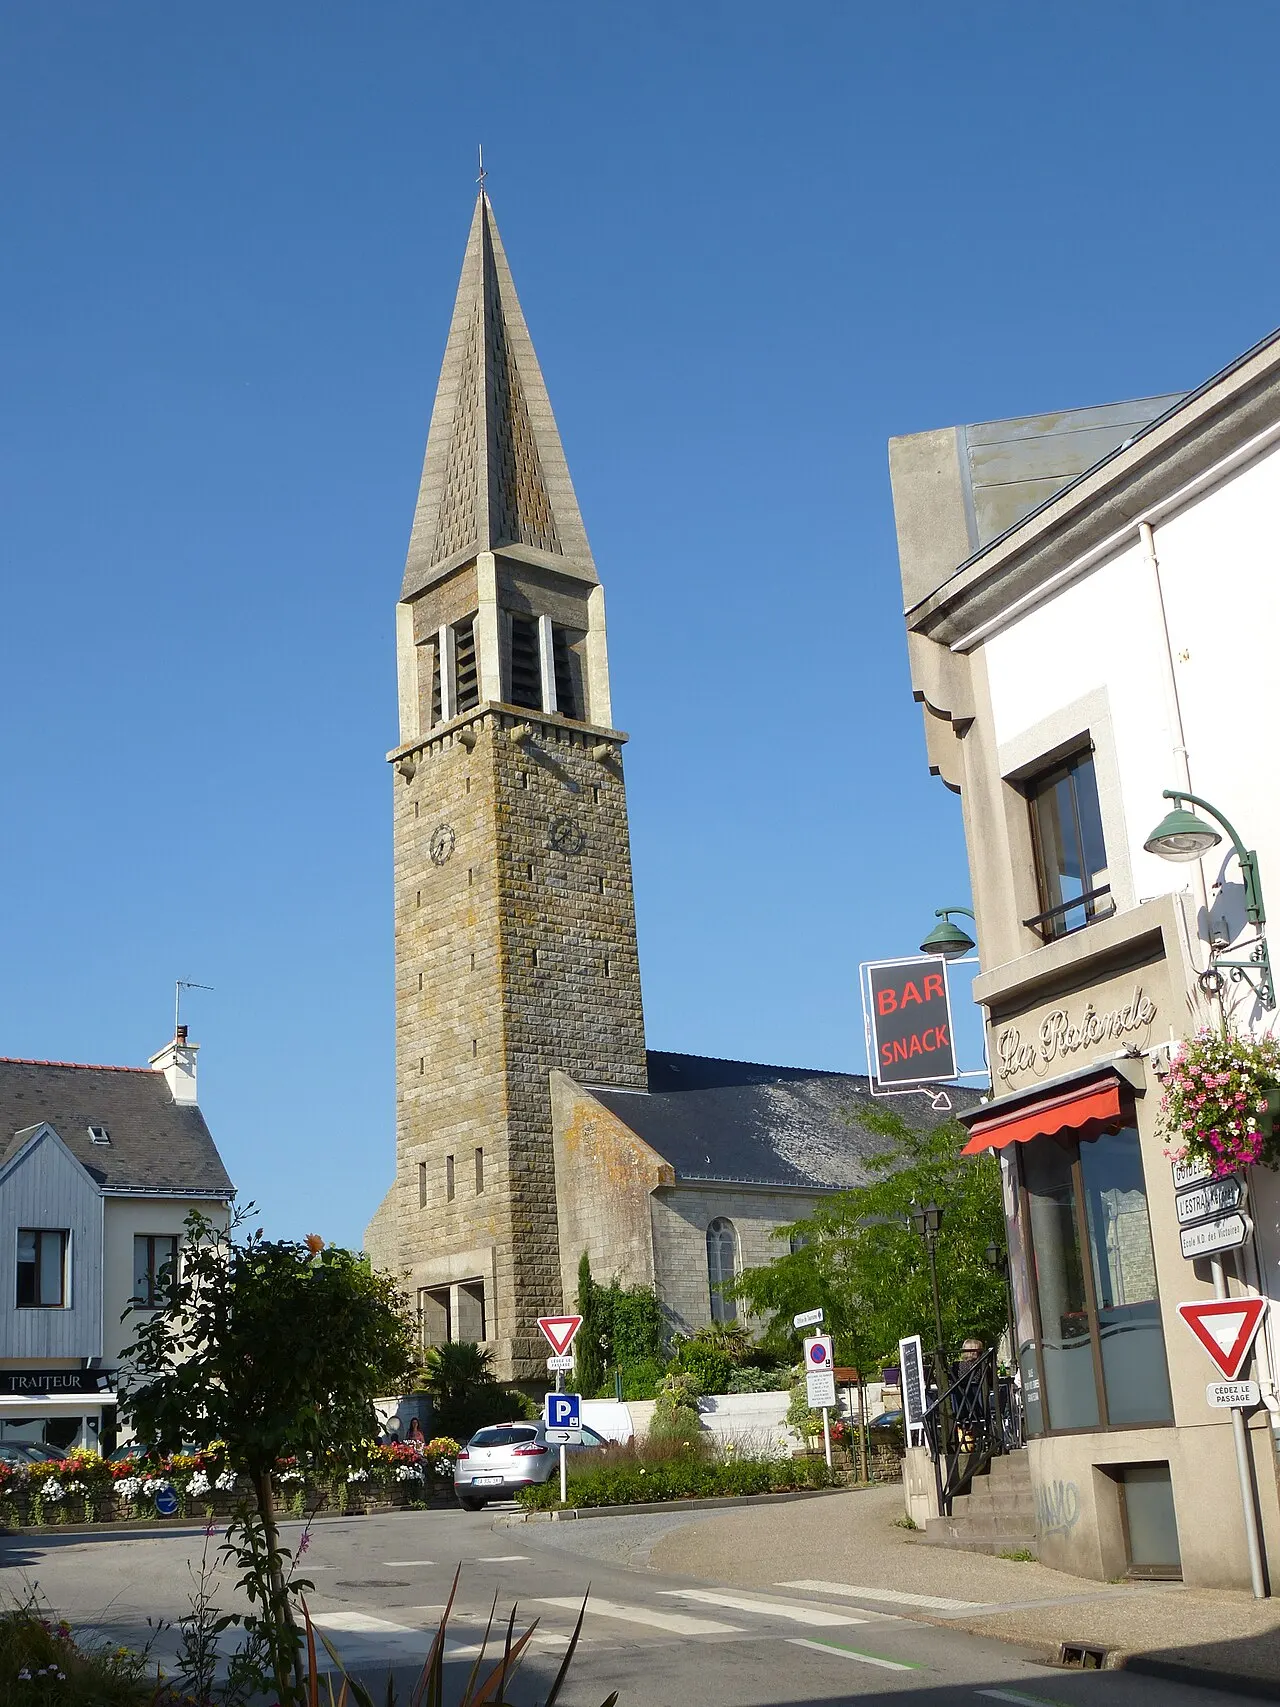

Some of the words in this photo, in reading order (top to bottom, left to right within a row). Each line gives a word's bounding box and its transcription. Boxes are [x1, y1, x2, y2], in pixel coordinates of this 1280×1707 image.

[877, 973, 945, 1016] BAR
[1039, 985, 1155, 1062] Rotonde
[881, 1024, 949, 1066] SNACK
[1208, 1231, 1217, 1241] des
[8, 1375, 82, 1391] TRAITEUR
[1214, 1386, 1238, 1394] CÉDEZ
[1216, 1394, 1250, 1402] PASSAGE
[556, 1400, 572, 1422] P
